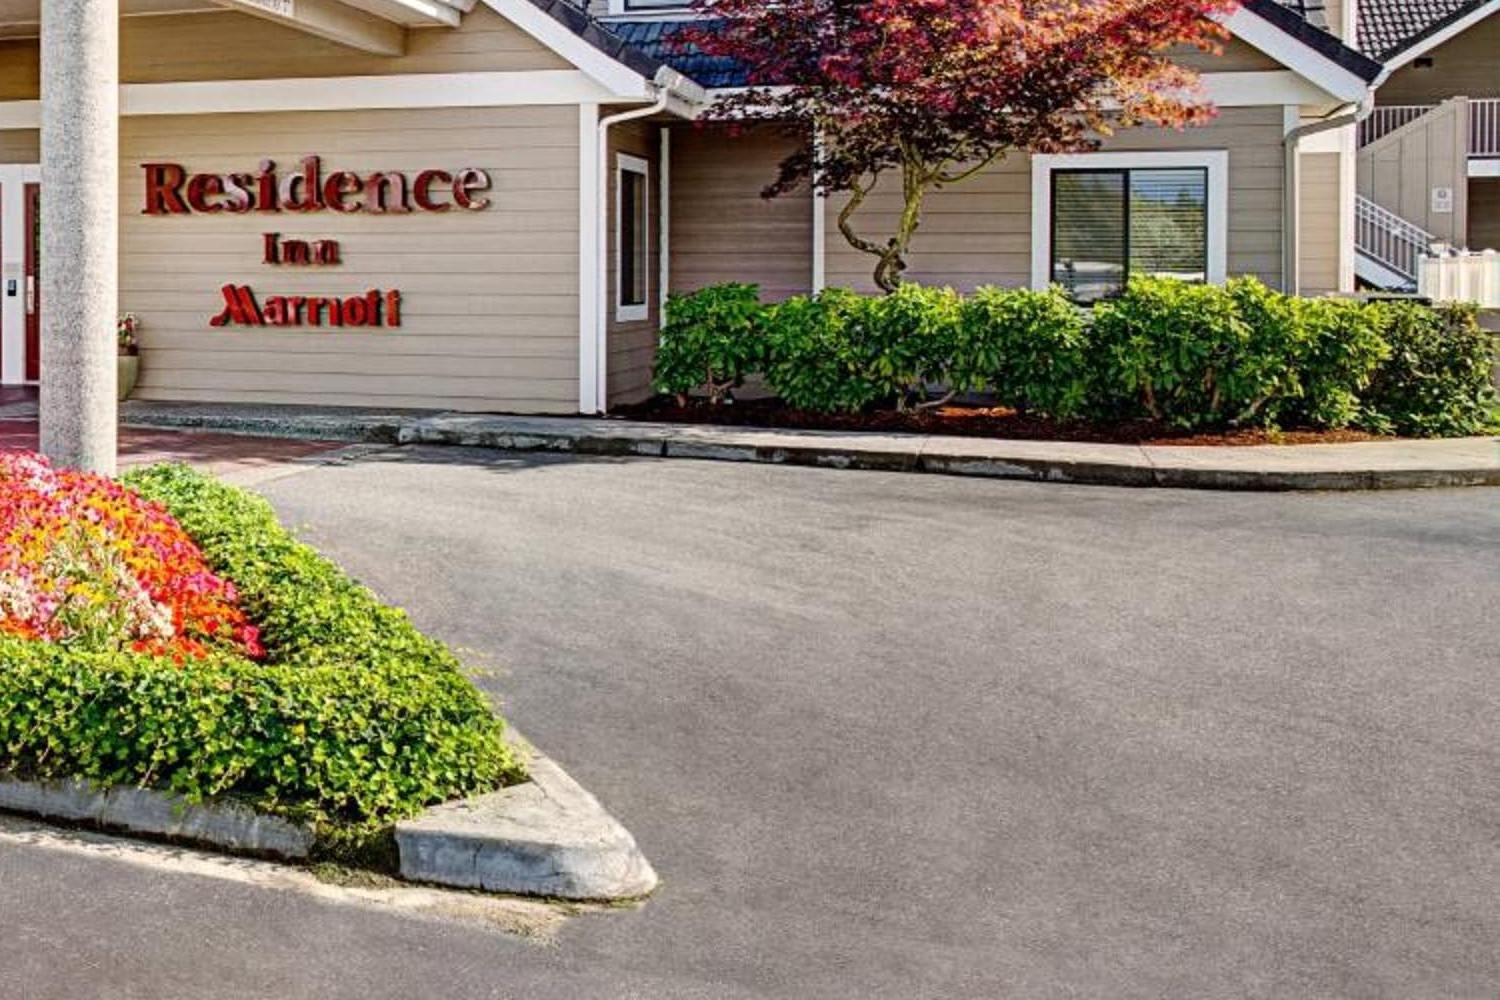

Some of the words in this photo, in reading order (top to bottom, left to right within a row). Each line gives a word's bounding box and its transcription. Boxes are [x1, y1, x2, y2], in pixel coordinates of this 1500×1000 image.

[140, 155, 492, 215] Residence
[262, 232, 341, 265] Inn
[209, 283, 403, 327] Marriott
